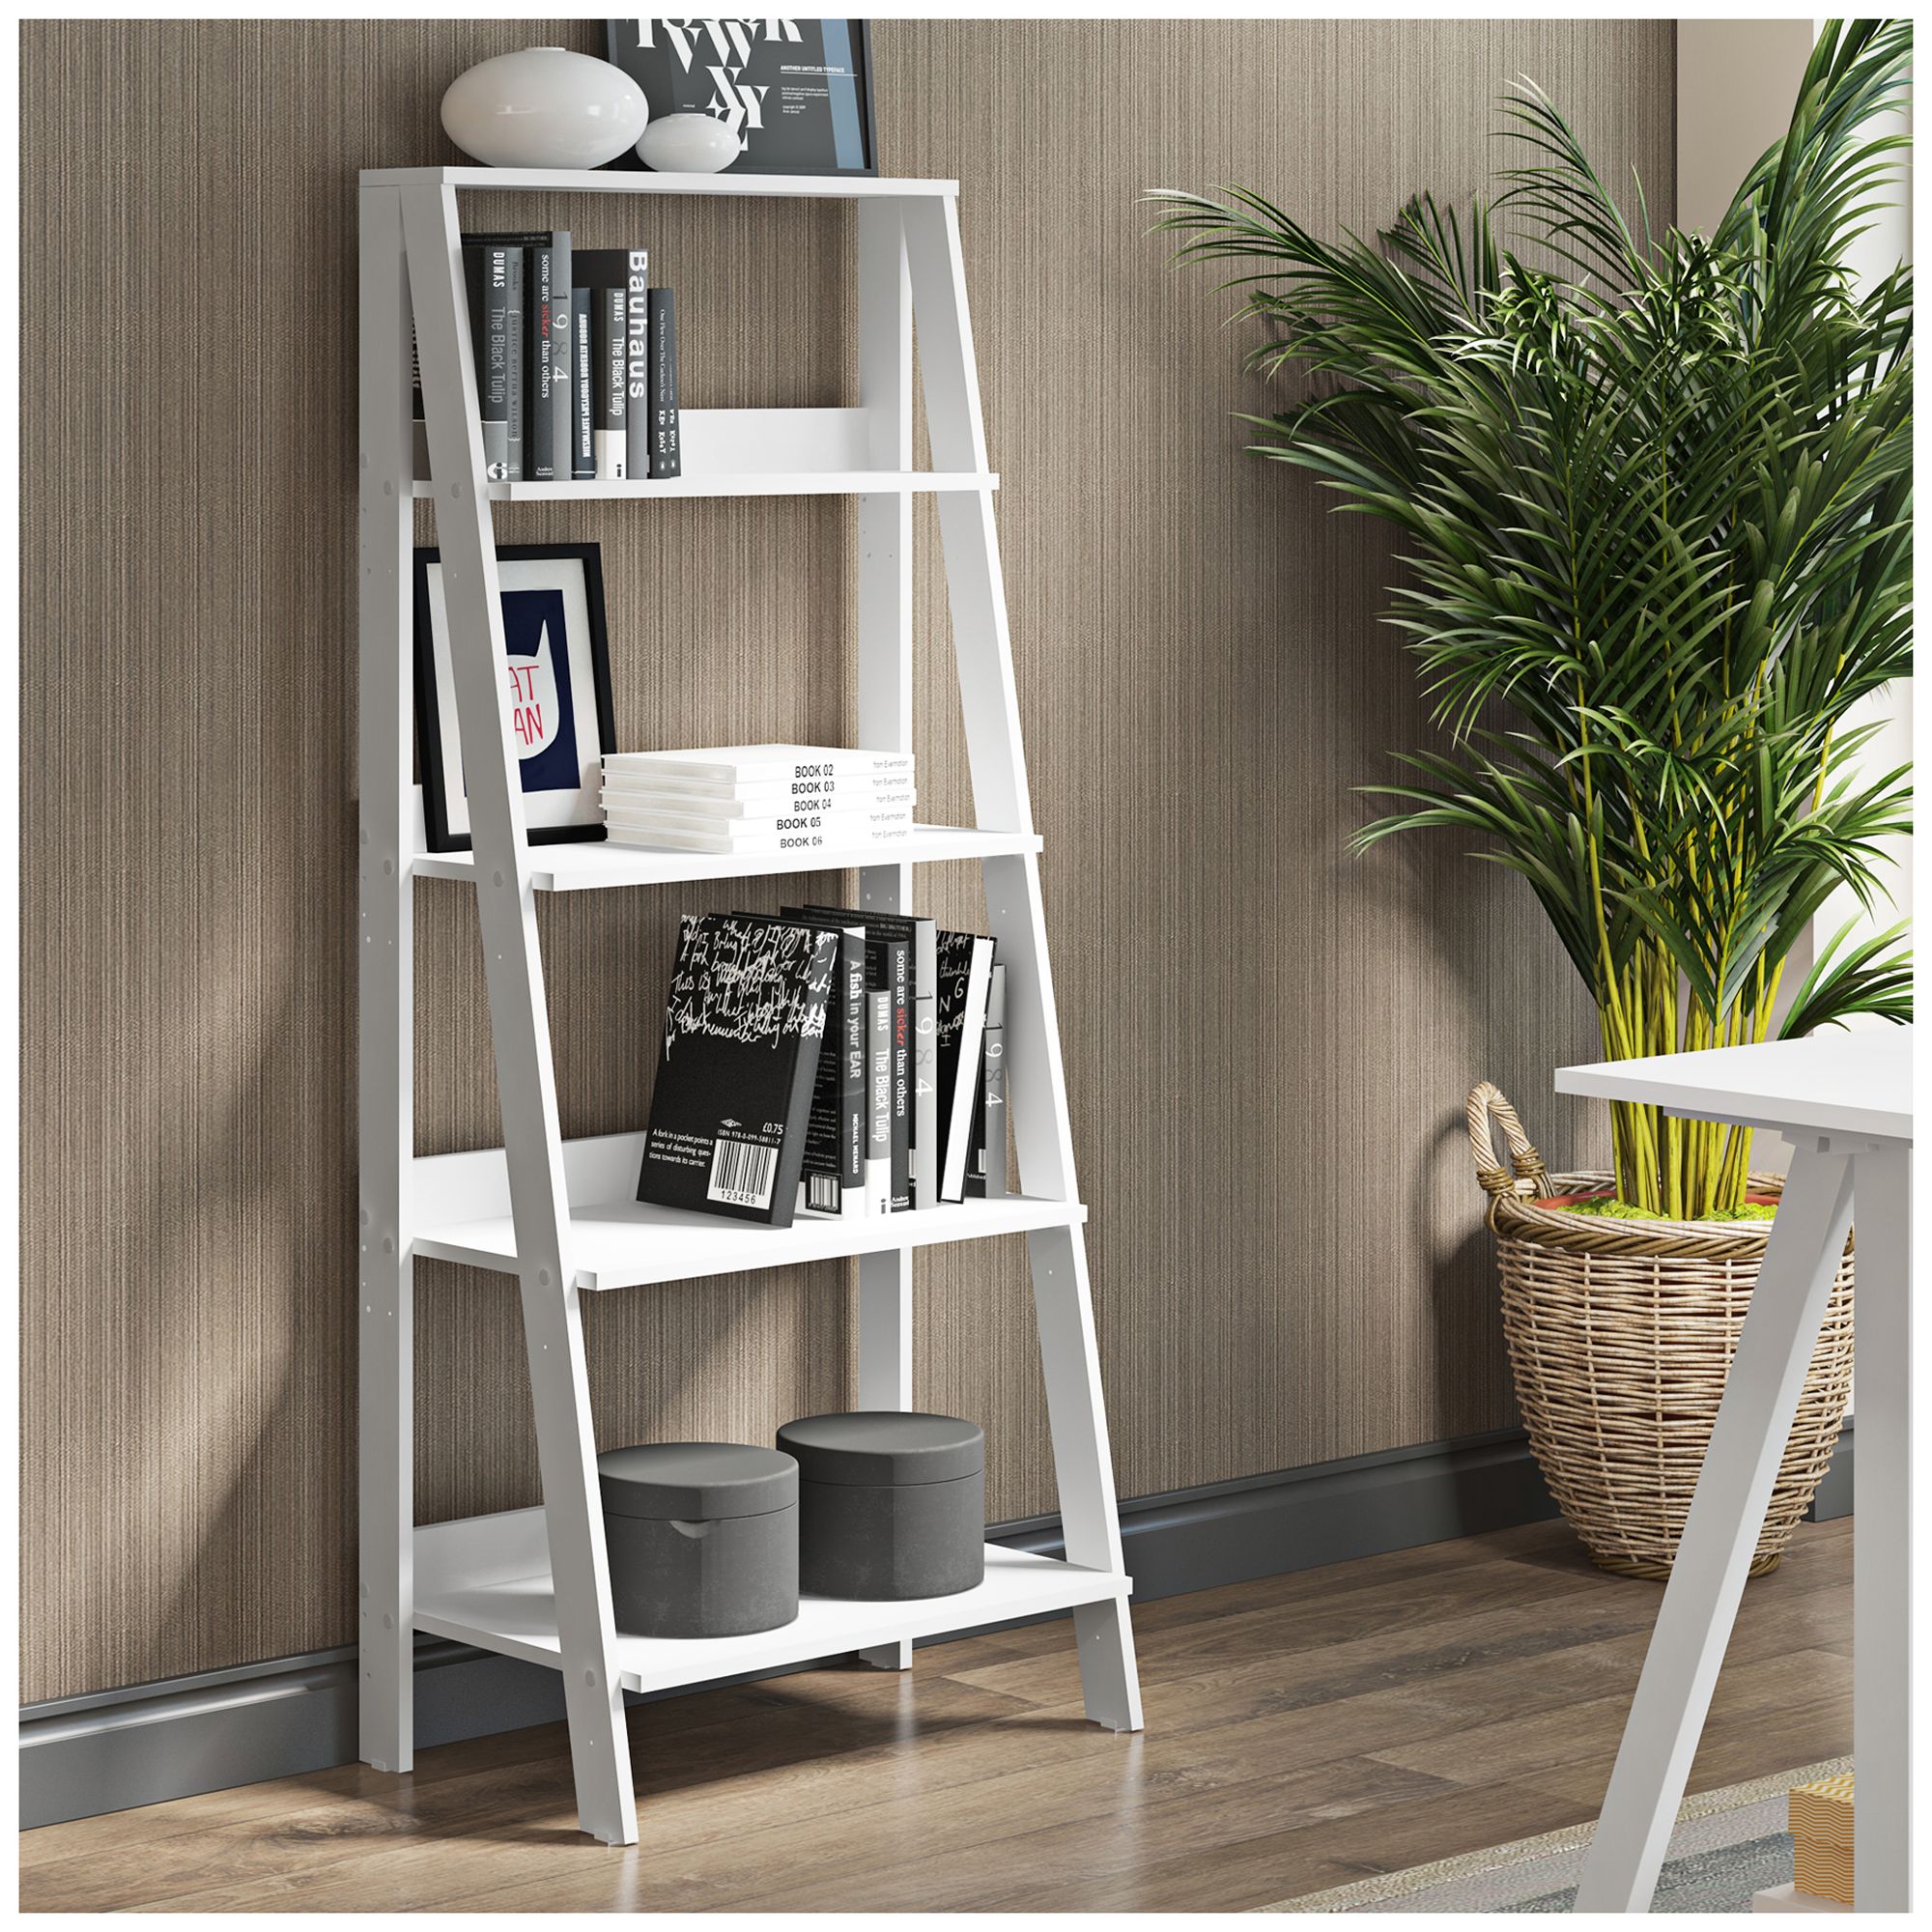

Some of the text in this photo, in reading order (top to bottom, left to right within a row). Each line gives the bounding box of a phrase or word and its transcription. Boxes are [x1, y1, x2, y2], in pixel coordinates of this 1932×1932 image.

[488, 252, 505, 404] DUMAS The Black Tulip
[541, 254, 551, 398] some are sicker than others
[629, 251, 648, 398] Bauhaus
[609, 292, 625, 416] DUMAS The Black Tulip
[508, 665, 540, 702] AT
[514, 703, 544, 746] AN
[795, 764, 821, 779] BOOK
[823, 763, 834, 777] 02
[791, 781, 821, 794] BOOK
[824, 781, 835, 792] 03
[794, 799, 820, 811] BOOK
[821, 798, 832, 810] 04
[777, 817, 808, 831] BOOK
[810, 816, 821, 828] 05
[780, 837, 810, 849] BOOK
[812, 836, 823, 846] 06
[850, 959, 862, 971] A
[849, 972, 863, 1000] fish
[849, 1002, 862, 1015] in
[847, 1017, 860, 1048] your
[896, 950, 908, 1117] some are sicker than others
[849, 1050, 862, 1079] EAR
[871, 996, 890, 1142] DUMAS The Black Tulip
[658, 1128, 668, 1138] fork
[676, 1133, 694, 1142] pocket
[761, 1122, 784, 1135] £0.75
[650, 1141, 666, 1150] series
[666, 1142, 673, 1151] of
[672, 1143, 696, 1156] disturbing
[662, 1153, 681, 1163] towards
[721, 1190, 756, 1205] 123456
